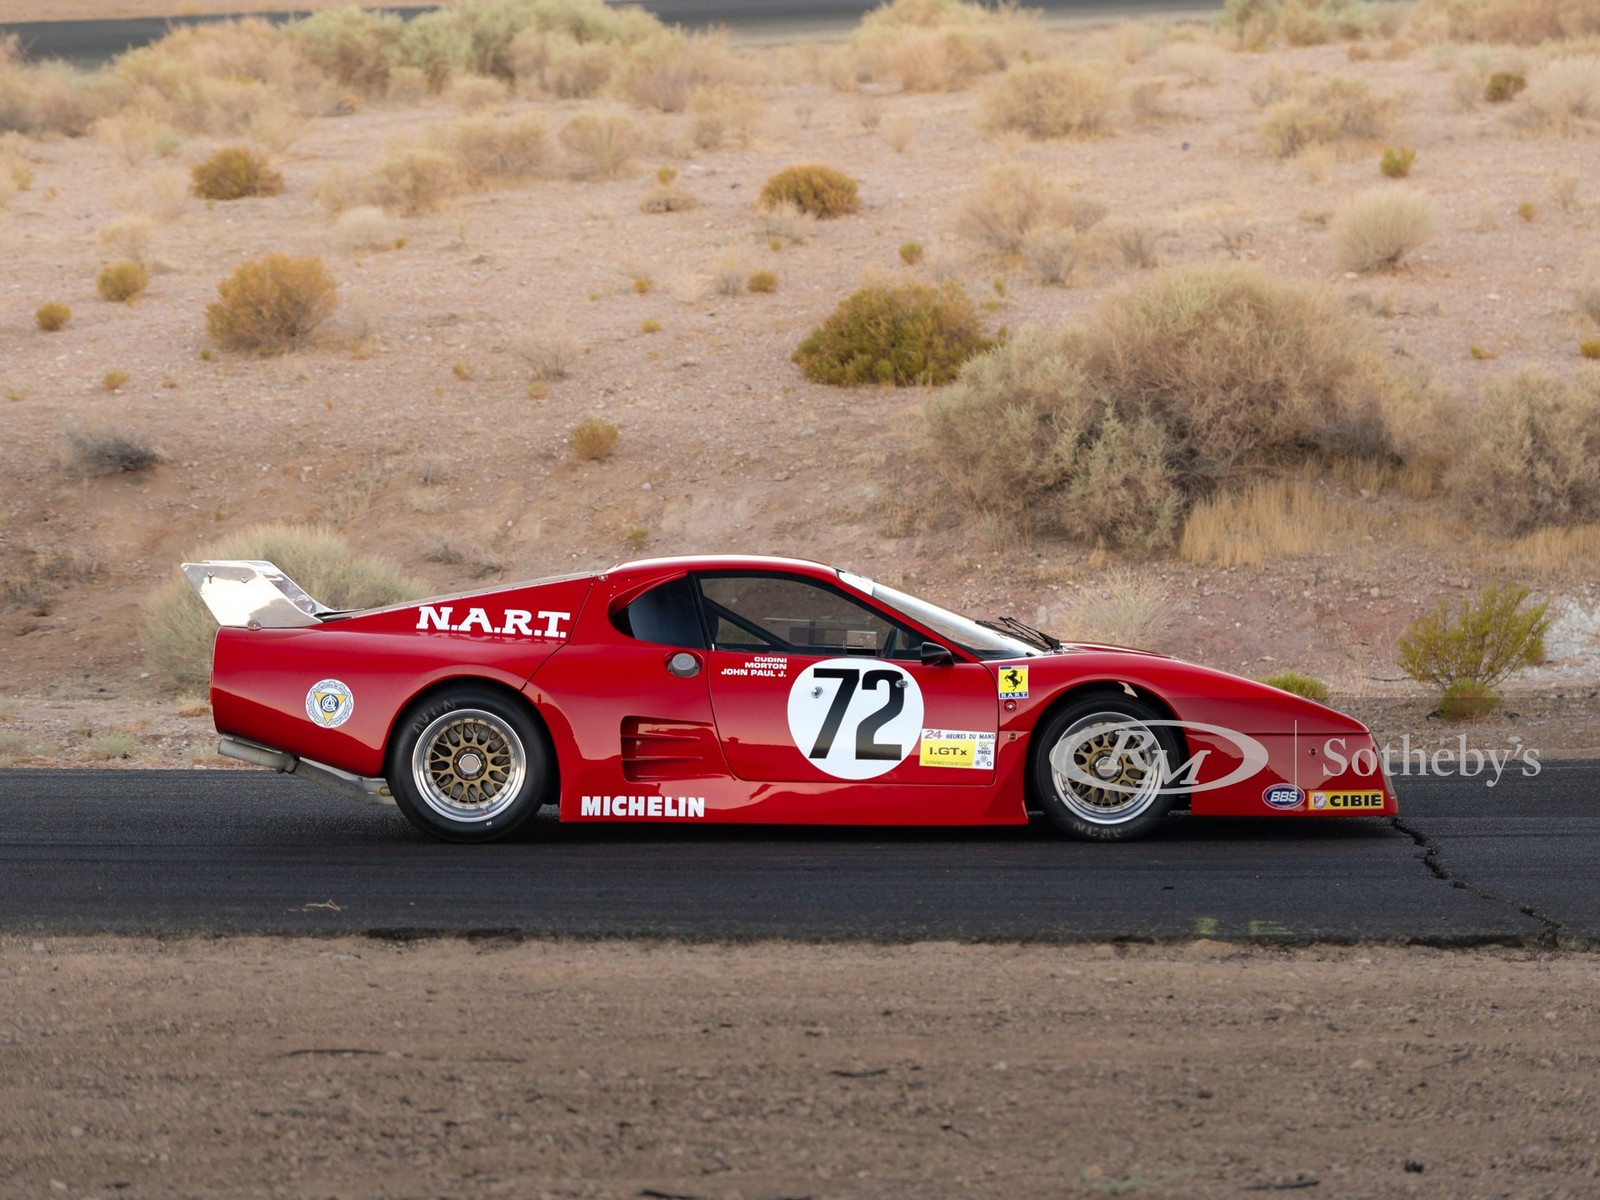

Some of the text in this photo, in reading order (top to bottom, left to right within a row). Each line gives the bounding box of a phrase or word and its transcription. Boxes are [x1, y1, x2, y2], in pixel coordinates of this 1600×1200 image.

[416, 606, 570, 638] N.A.R.T.
[744, 662, 787, 670] MORTON
[721, 668, 748, 676] JOHN
[751, 669, 776, 677] PAUL
[808, 667, 905, 761] 72
[924, 730, 943, 739] 24
[1270, 791, 1298, 802] BBS
[581, 795, 705, 817] MICHELIN
